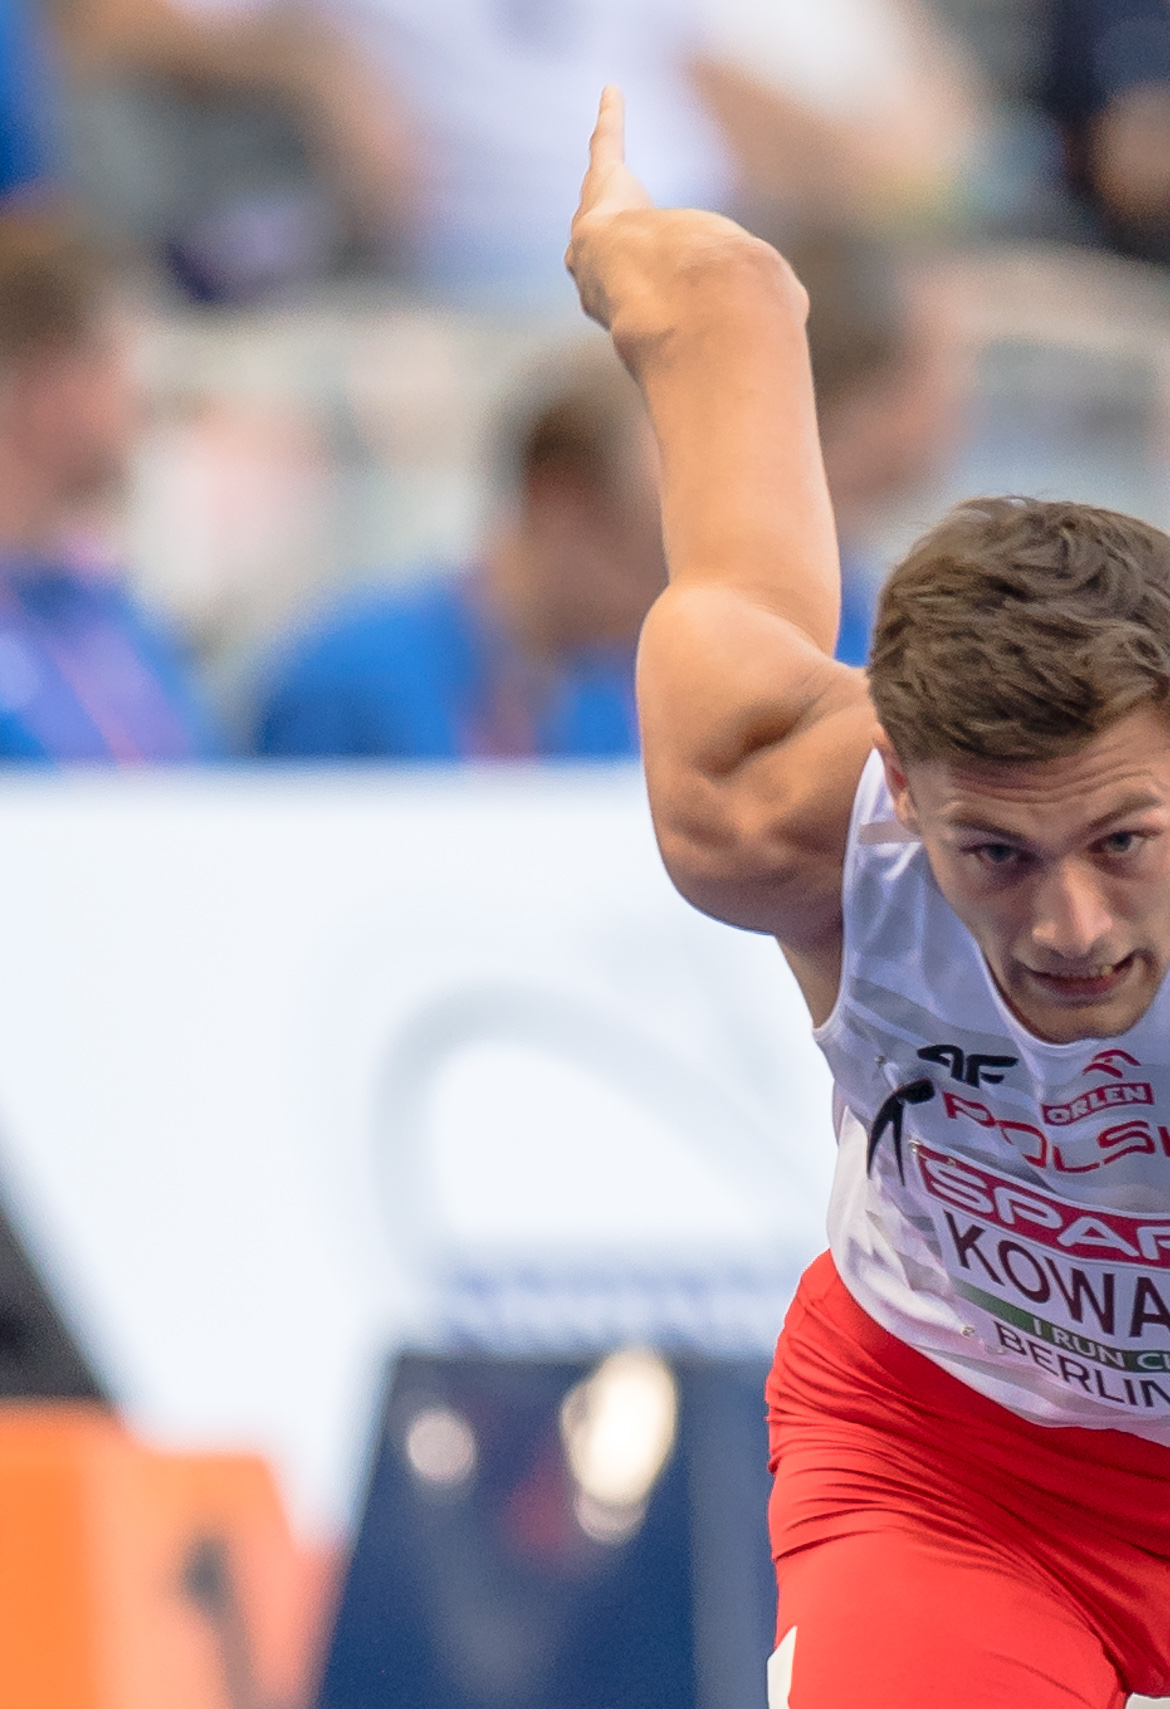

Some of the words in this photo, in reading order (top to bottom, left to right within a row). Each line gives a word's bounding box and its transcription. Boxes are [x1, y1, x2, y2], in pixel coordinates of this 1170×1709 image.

[1046, 1085, 1148, 1124] ORLEN
[1032, 1317, 1042, 1337] I
[1051, 1325, 1125, 1371] RUN
